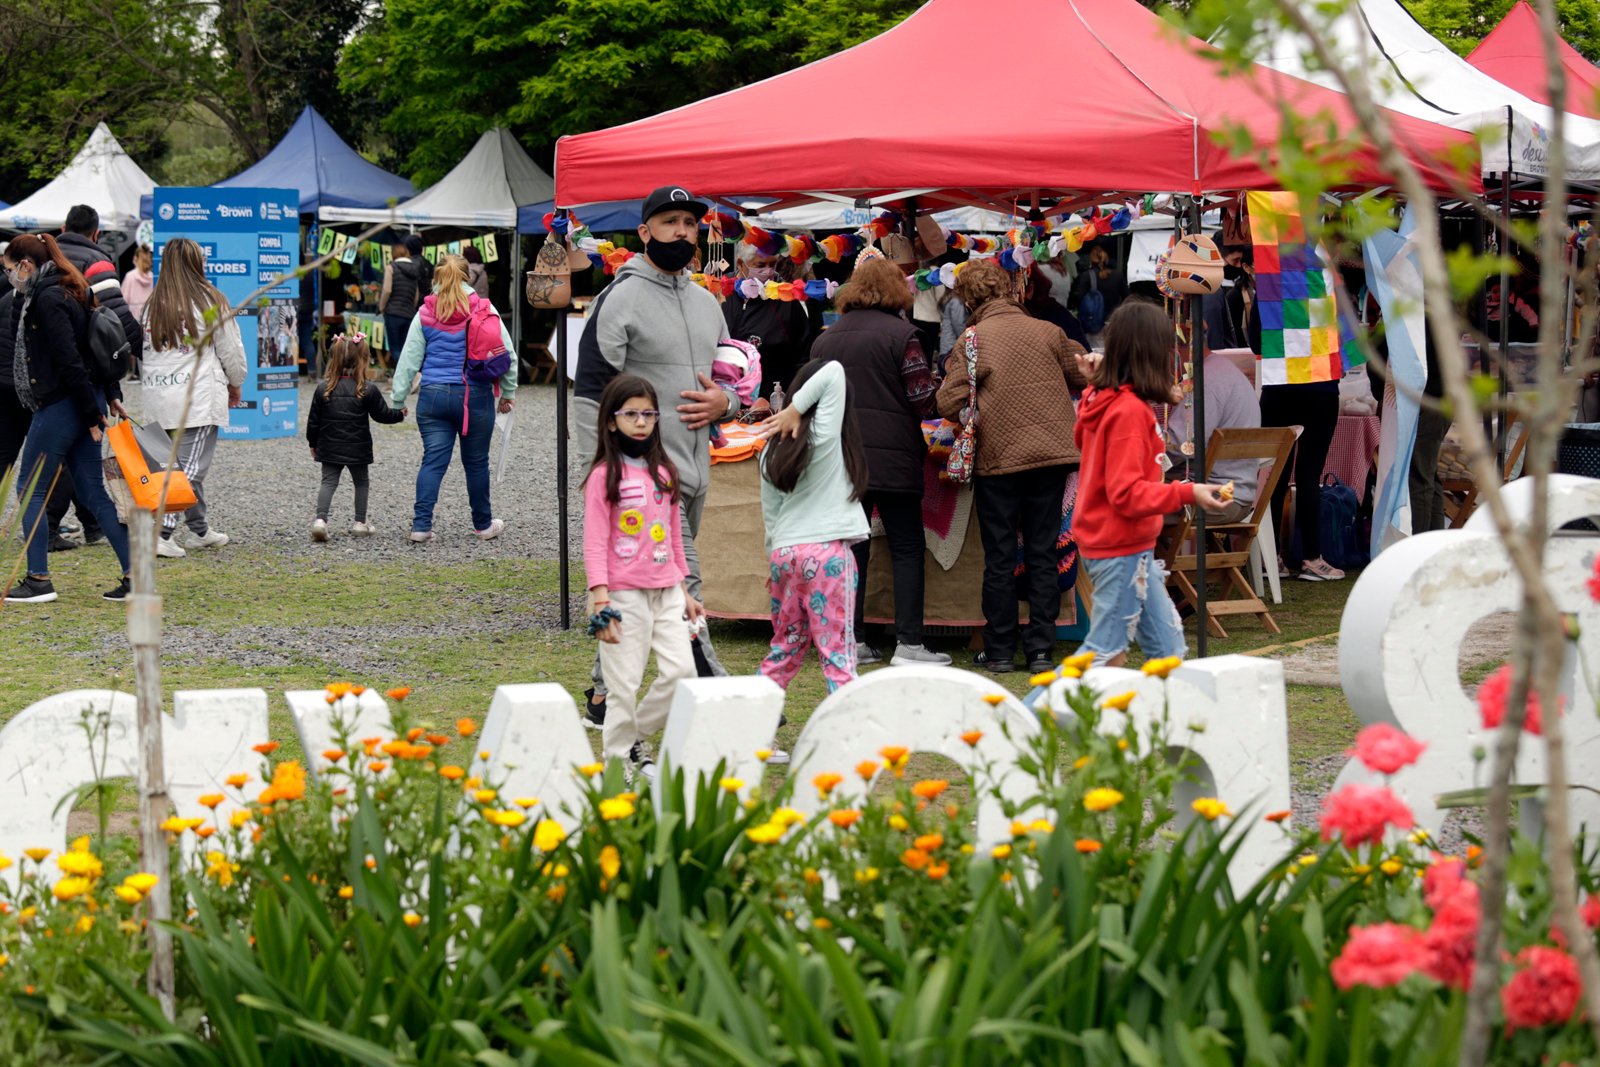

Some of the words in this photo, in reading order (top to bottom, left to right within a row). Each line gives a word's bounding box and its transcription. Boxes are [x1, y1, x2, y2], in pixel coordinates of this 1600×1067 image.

[221, 206, 253, 218] Brown
[260, 236, 281, 248] COMPRÁ
[260, 254, 290, 265] PRODUCTOS
